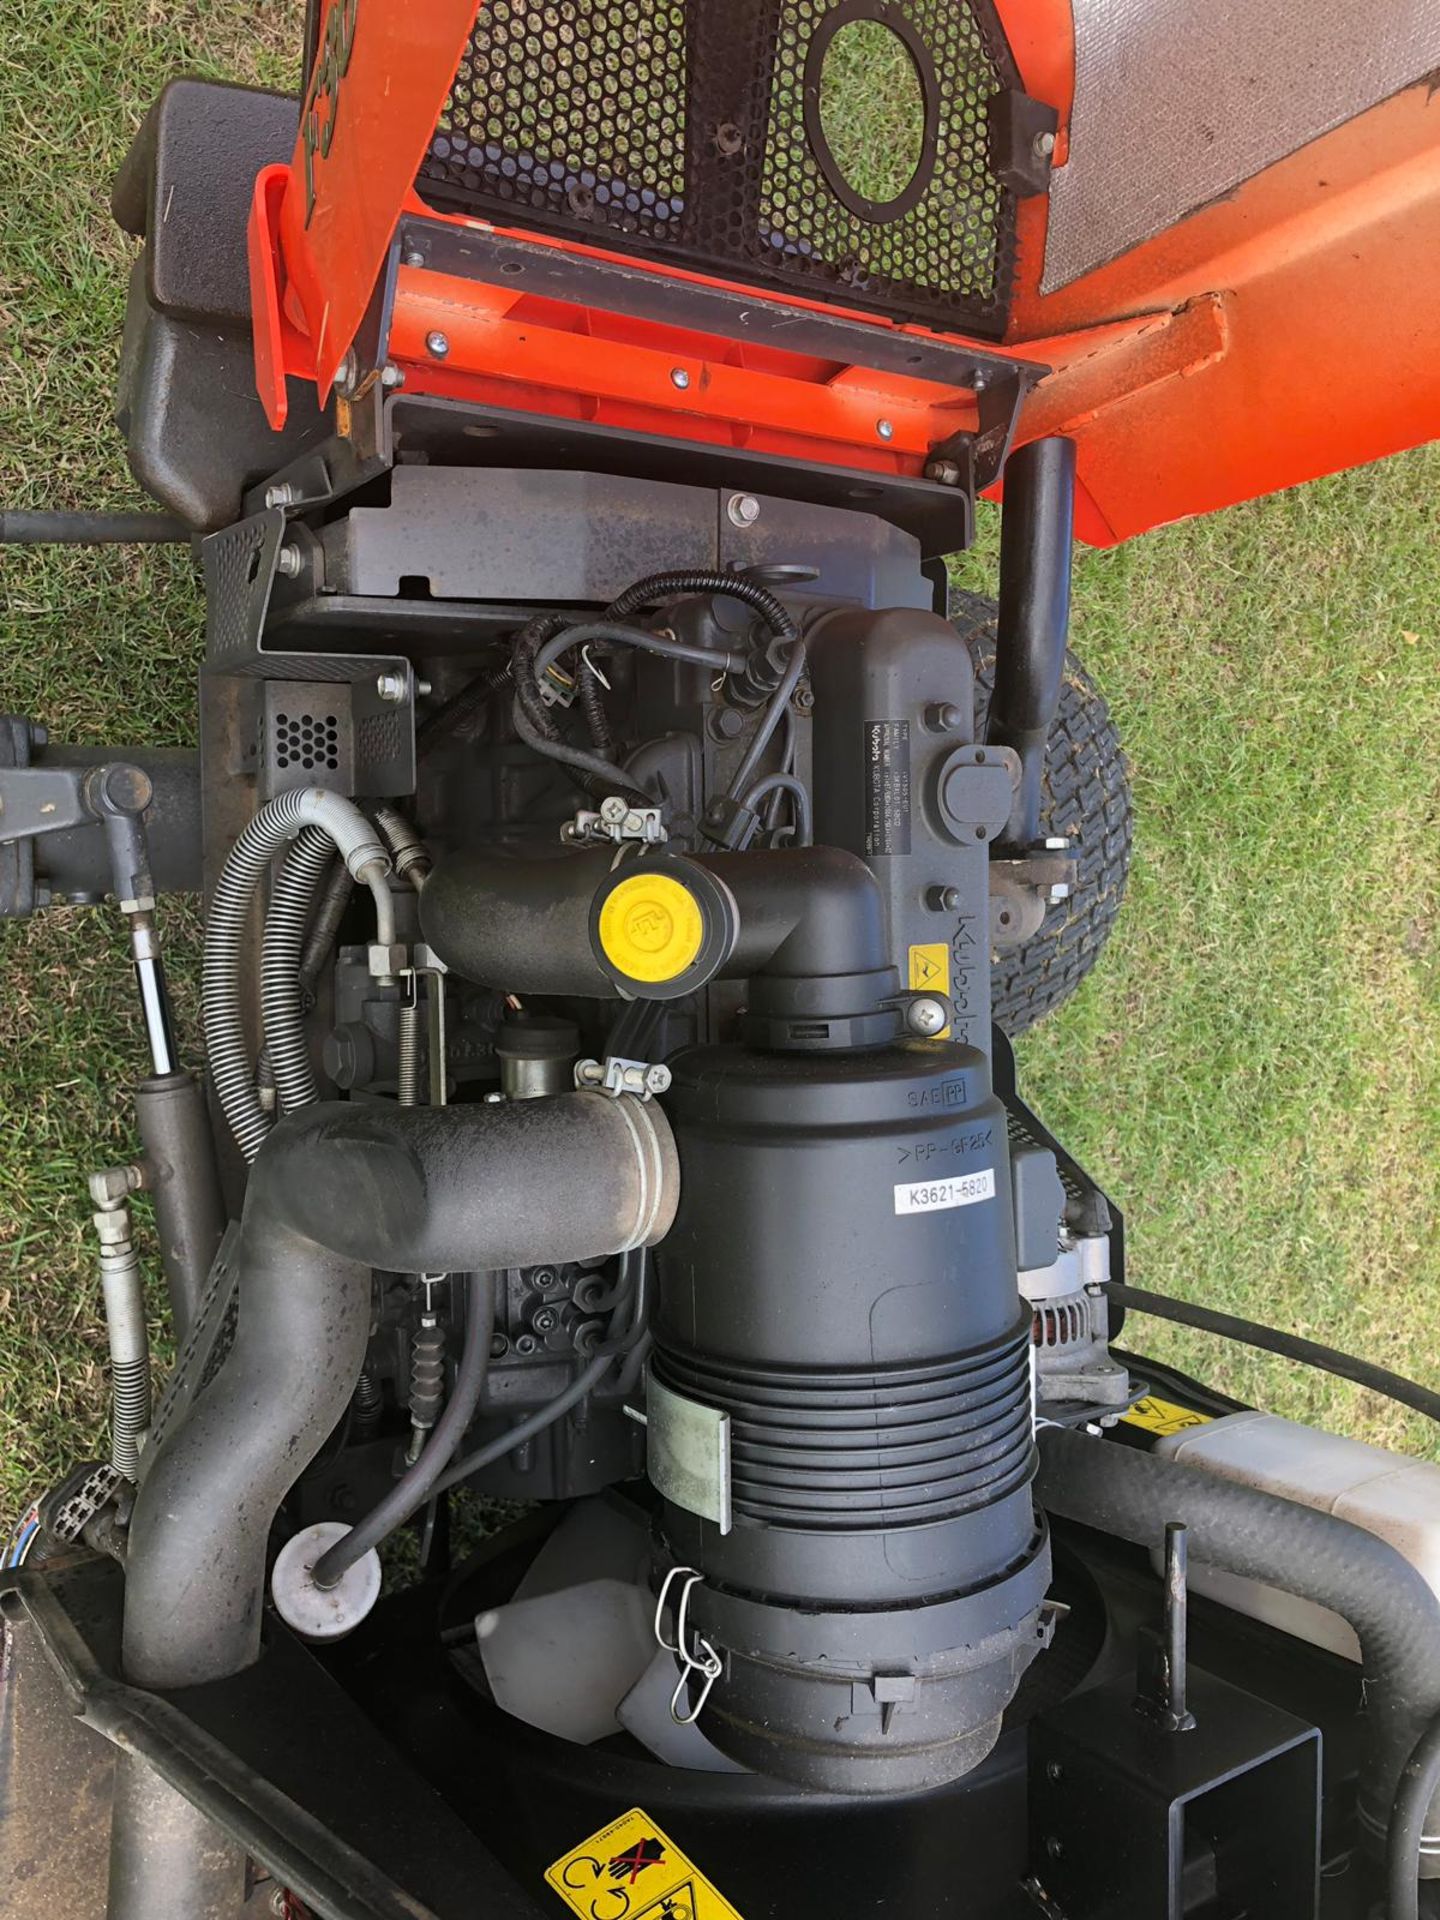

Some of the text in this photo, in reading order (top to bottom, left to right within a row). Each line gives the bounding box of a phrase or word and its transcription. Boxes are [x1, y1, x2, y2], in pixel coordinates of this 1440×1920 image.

[871, 725, 881, 761] Kubota
[872, 796, 881, 847] Corporation
[907, 1088, 941, 1107] SAE
[909, 1176, 988, 1206] K3621-5820
